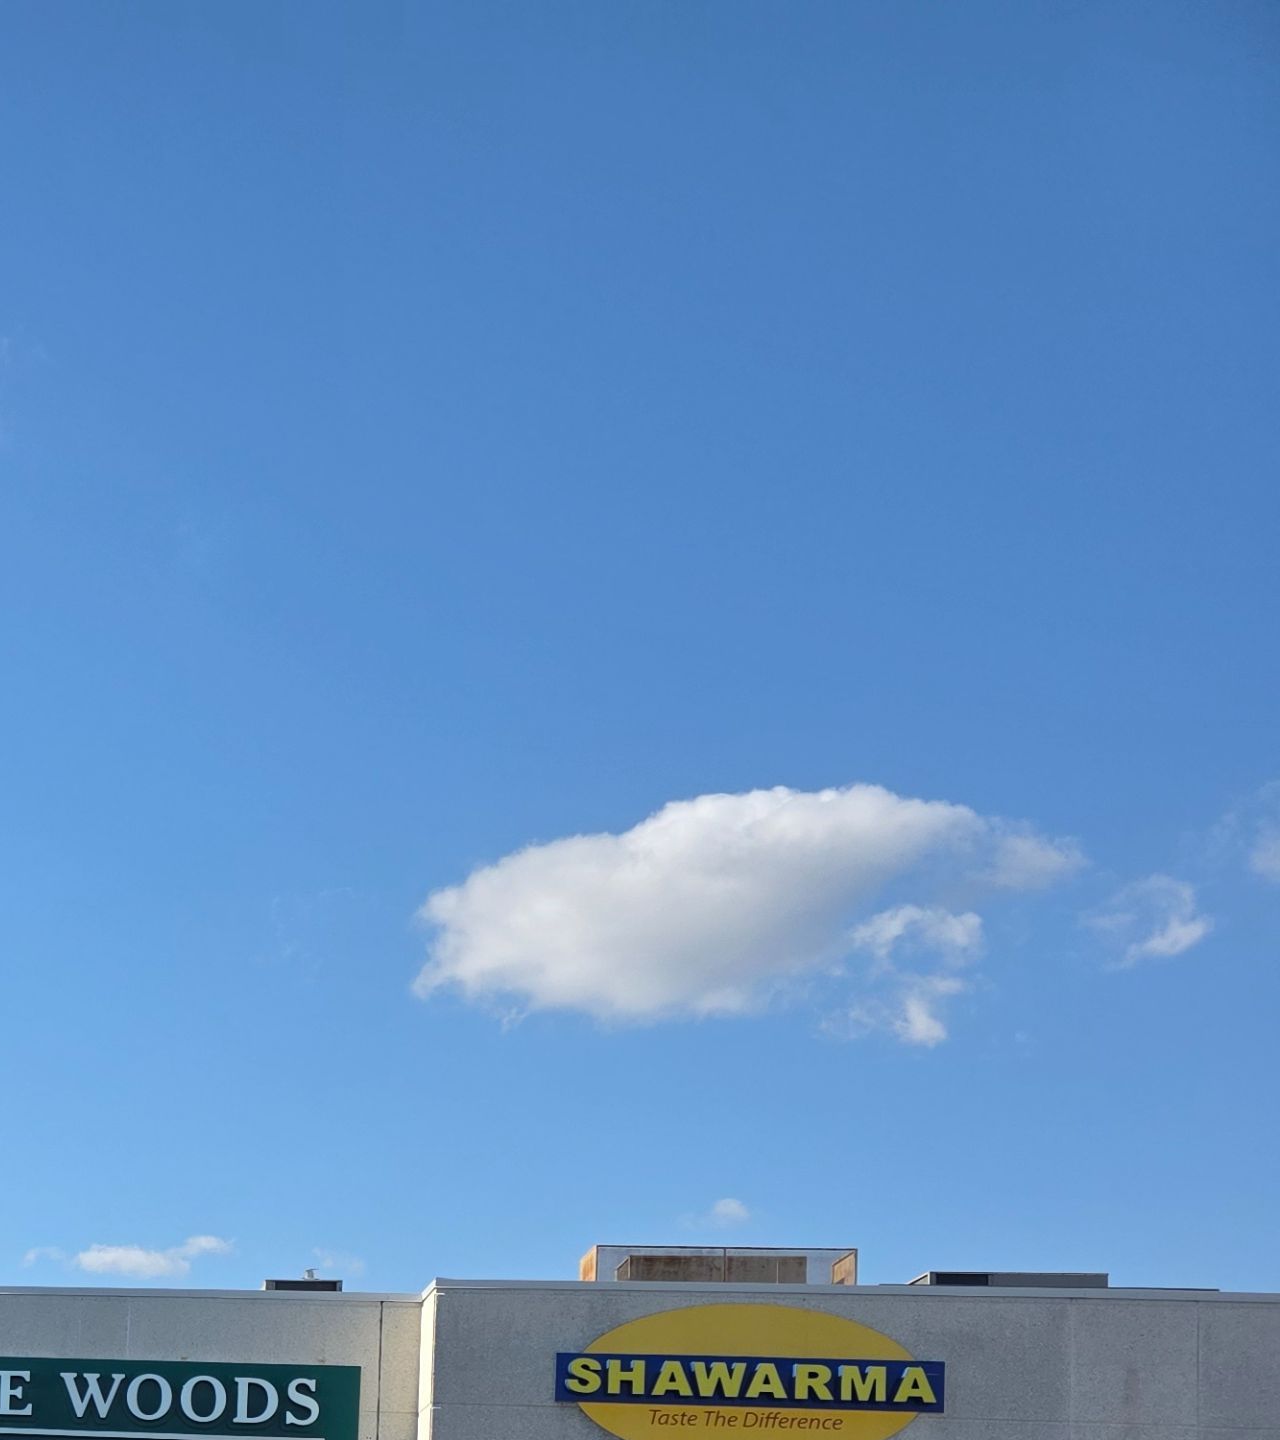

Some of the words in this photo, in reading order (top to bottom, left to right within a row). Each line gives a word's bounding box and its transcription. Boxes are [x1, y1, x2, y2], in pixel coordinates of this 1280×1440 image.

[61, 1372, 321, 1426] WOODS
[565, 1356, 936, 1404] SHAWARMA
[648, 1409, 697, 1428] Taste
[703, 1410, 737, 1428] The
[743, 1411, 843, 1431] Difference
